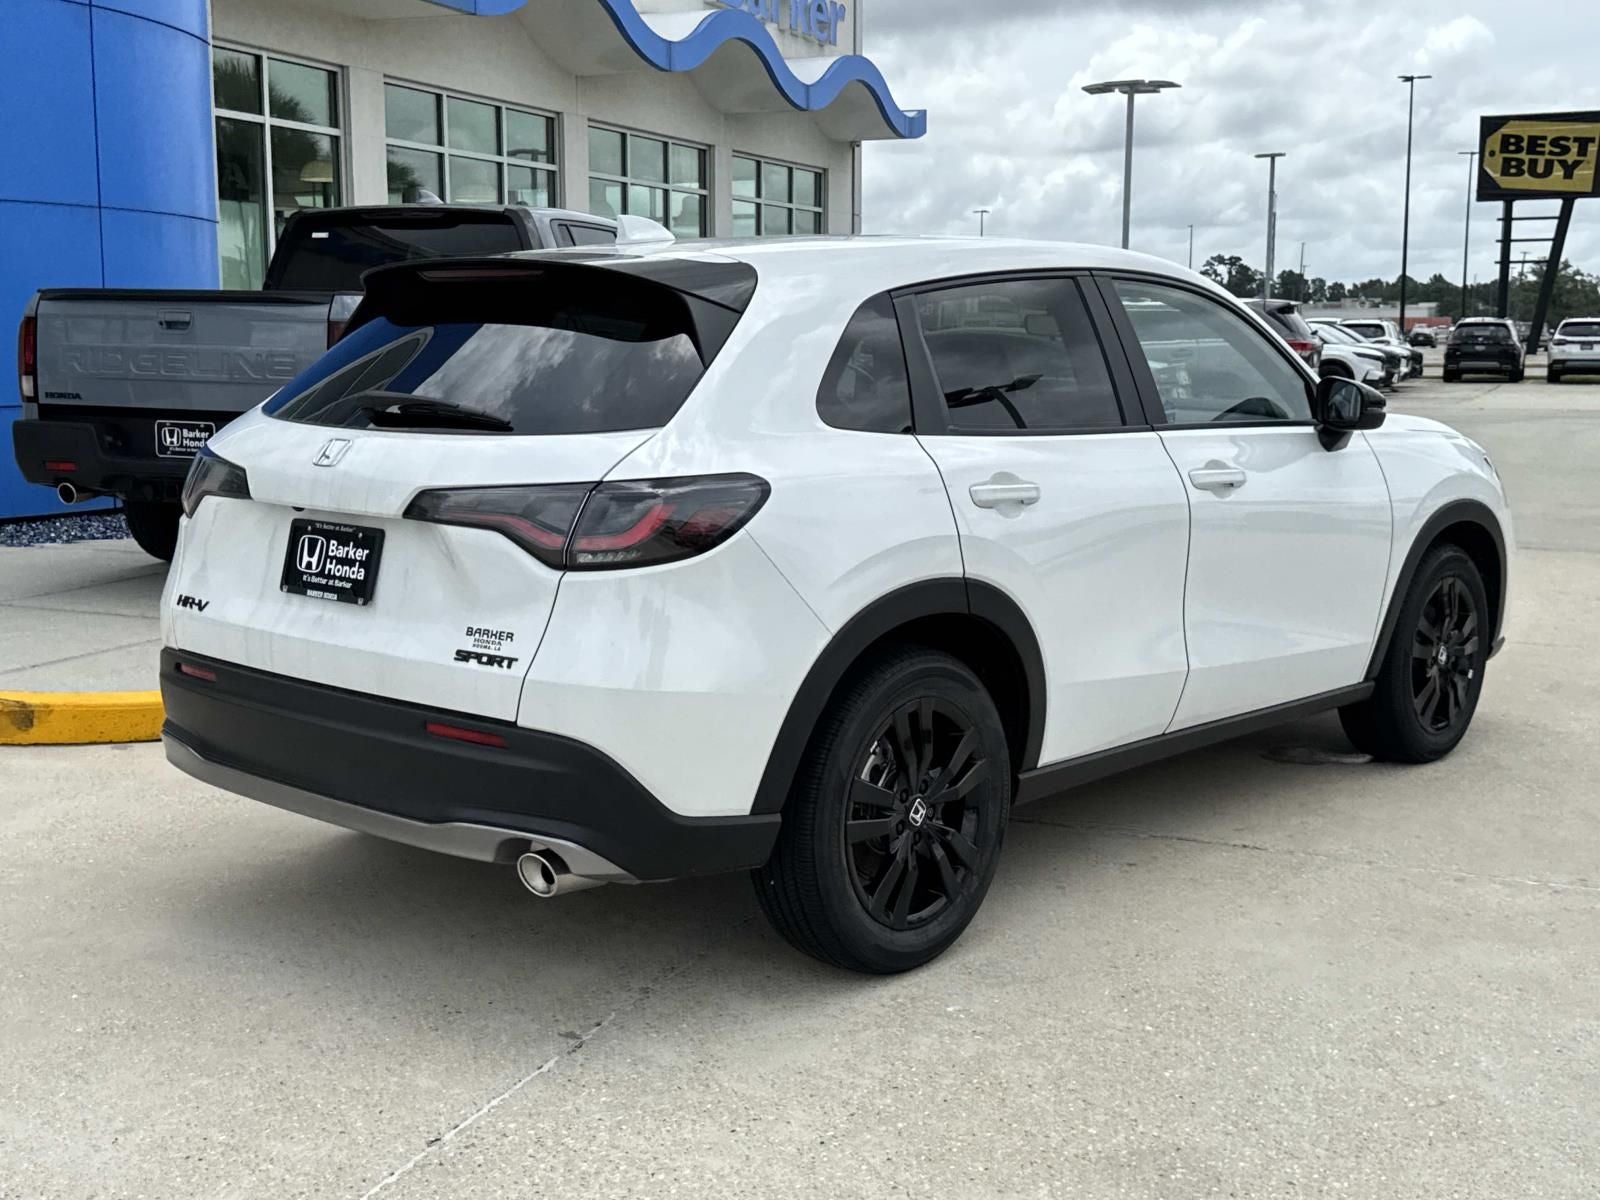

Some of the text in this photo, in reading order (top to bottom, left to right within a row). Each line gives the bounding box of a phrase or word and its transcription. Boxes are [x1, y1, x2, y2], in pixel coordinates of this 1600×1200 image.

[1499, 134, 1596, 157] BEST
[1500, 157, 1585, 180] BUY
[58, 351, 296, 379] RIDGELINE
[45, 392, 82, 400] HONDA
[182, 429, 209, 438] Barker
[182, 438, 206, 448] Hond
[328, 540, 369, 561] Barker
[325, 558, 365, 580] Honda
[311, 575, 328, 584] Better
[328, 578, 334, 586] at
[334, 579, 352, 589] Barker
[176, 594, 210, 612] HR-V
[466, 626, 514, 642] BARKER
[473, 638, 502, 646] HONDA
[454, 649, 519, 669] SPORT
